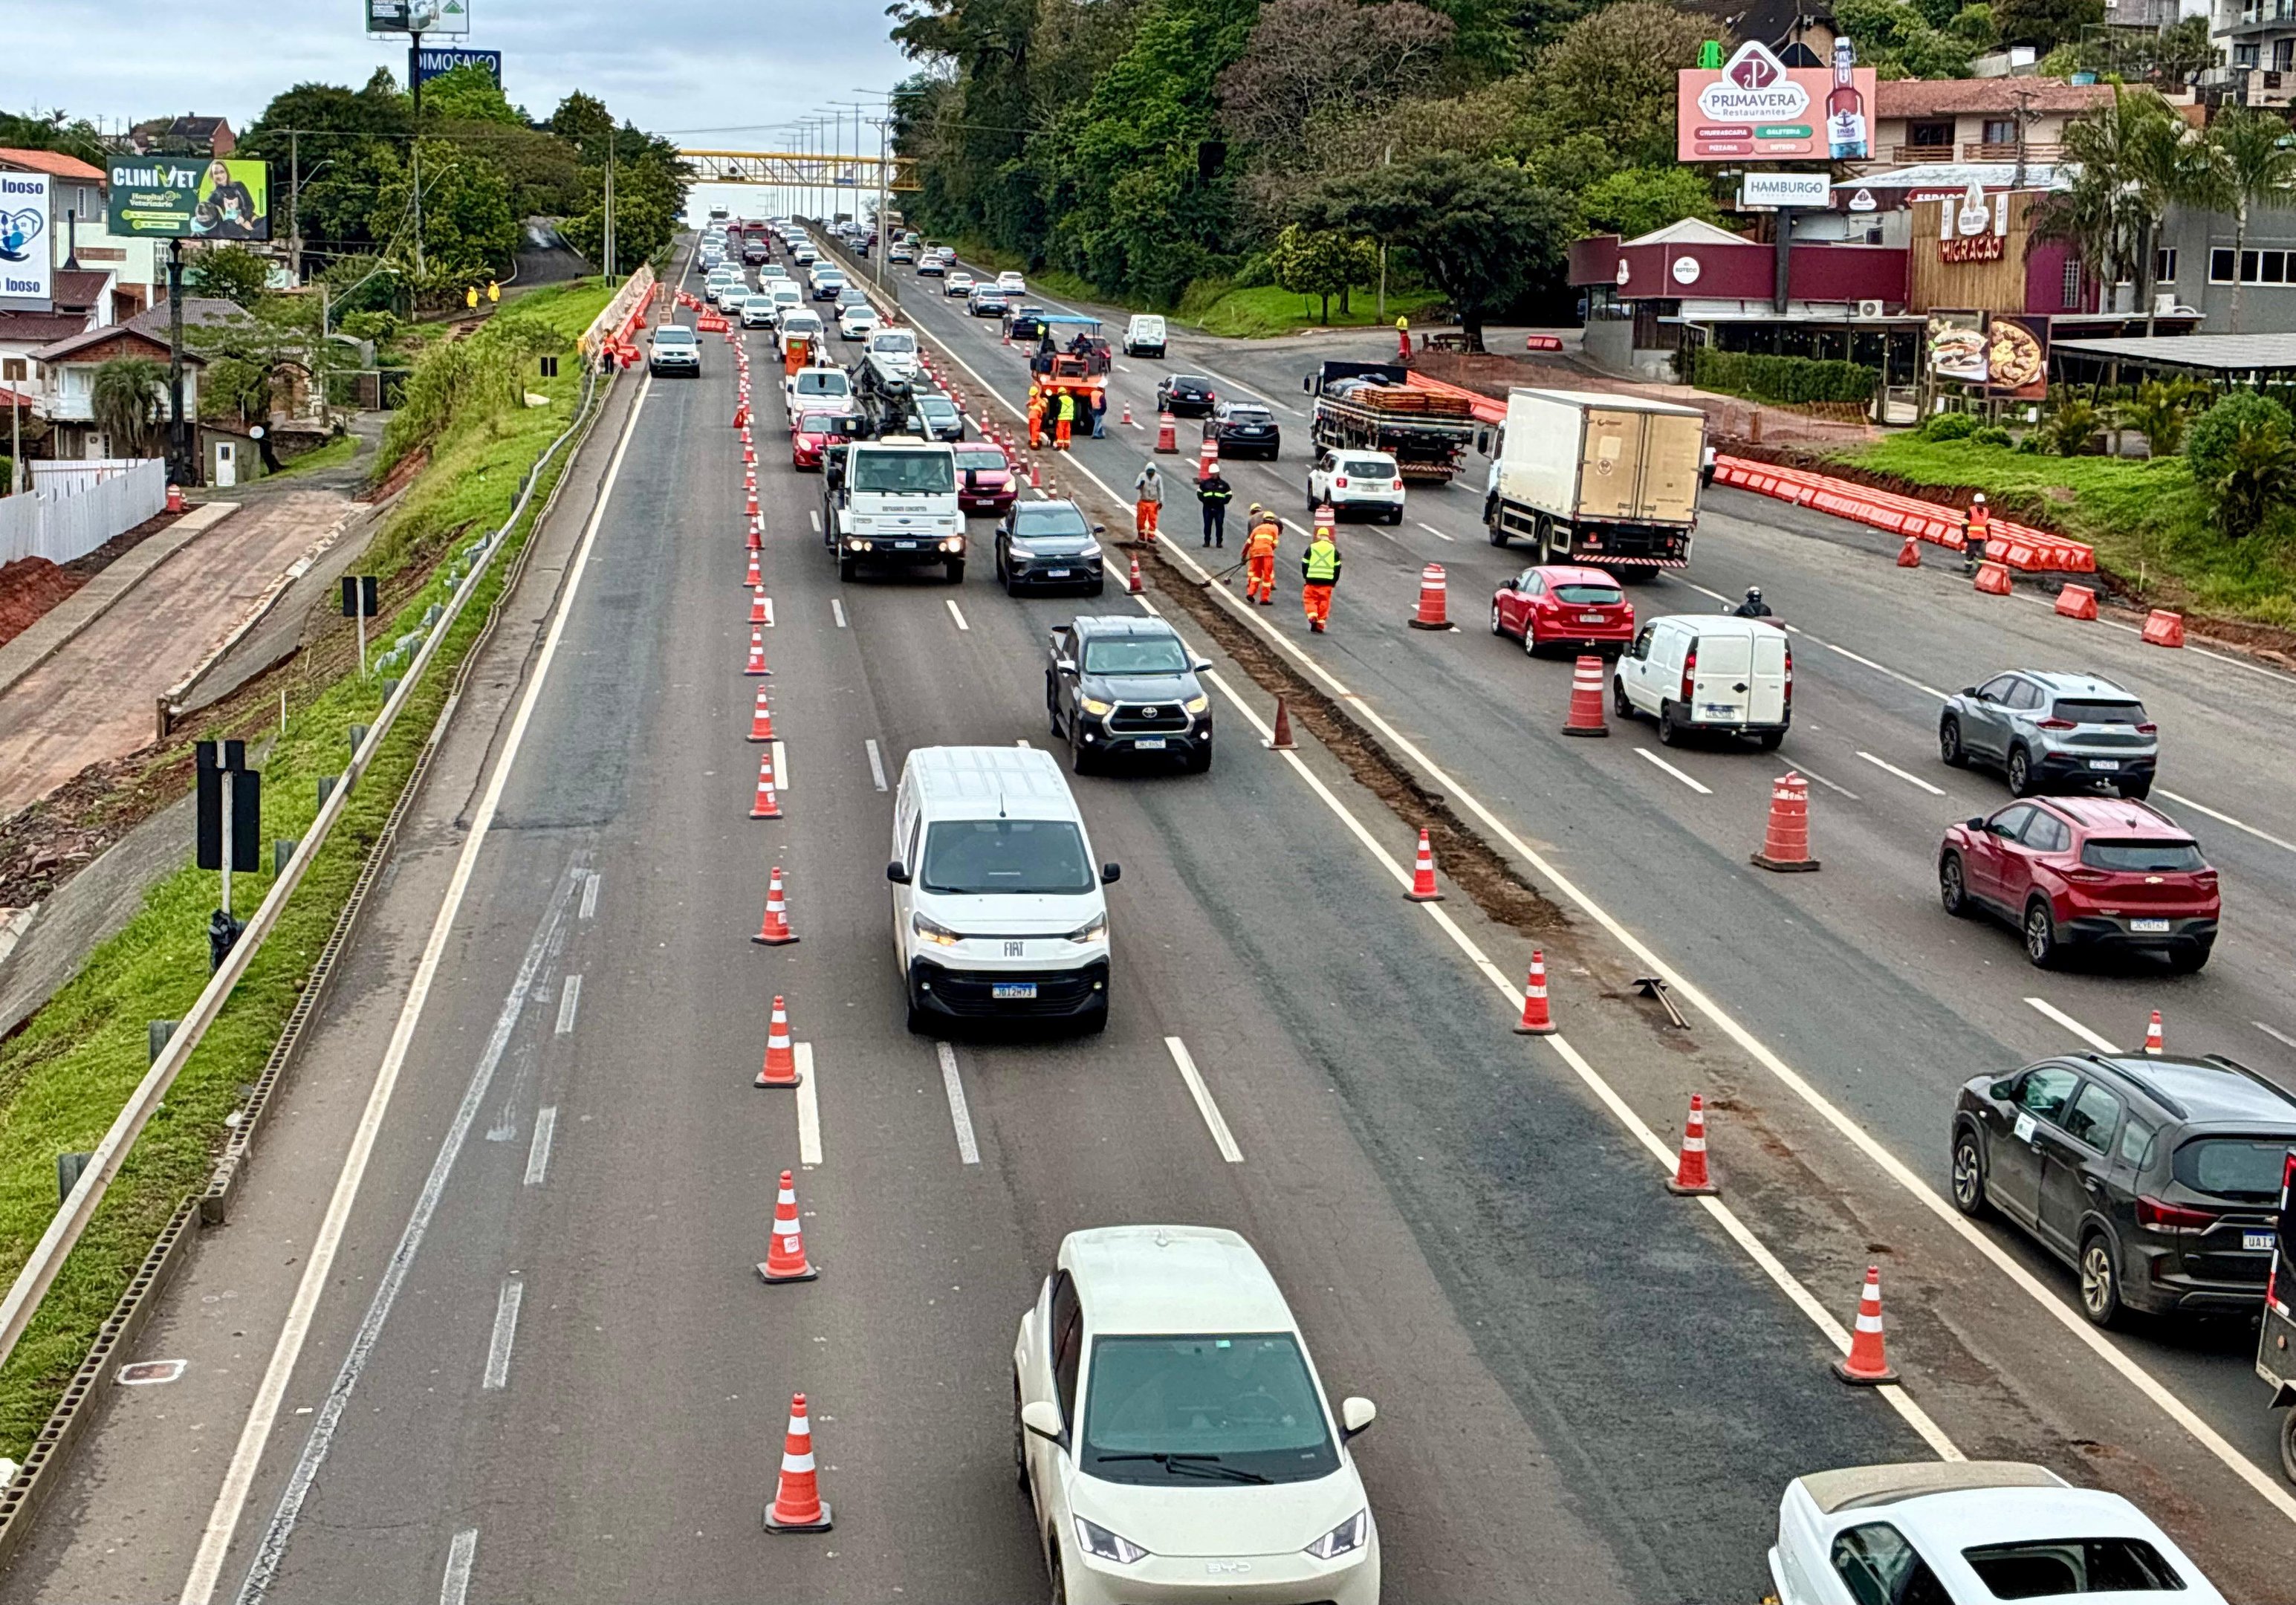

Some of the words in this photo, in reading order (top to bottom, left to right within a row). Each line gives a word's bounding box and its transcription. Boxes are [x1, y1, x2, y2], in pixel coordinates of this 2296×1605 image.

[1711, 94, 1797, 107] PRIMAVERA
[1723, 108, 1786, 117] Restaurantes
[113, 164, 197, 188] CLINIVET
[1751, 181, 1823, 193] HAMBURGO
[1004, 941, 1024, 956] FIAT
